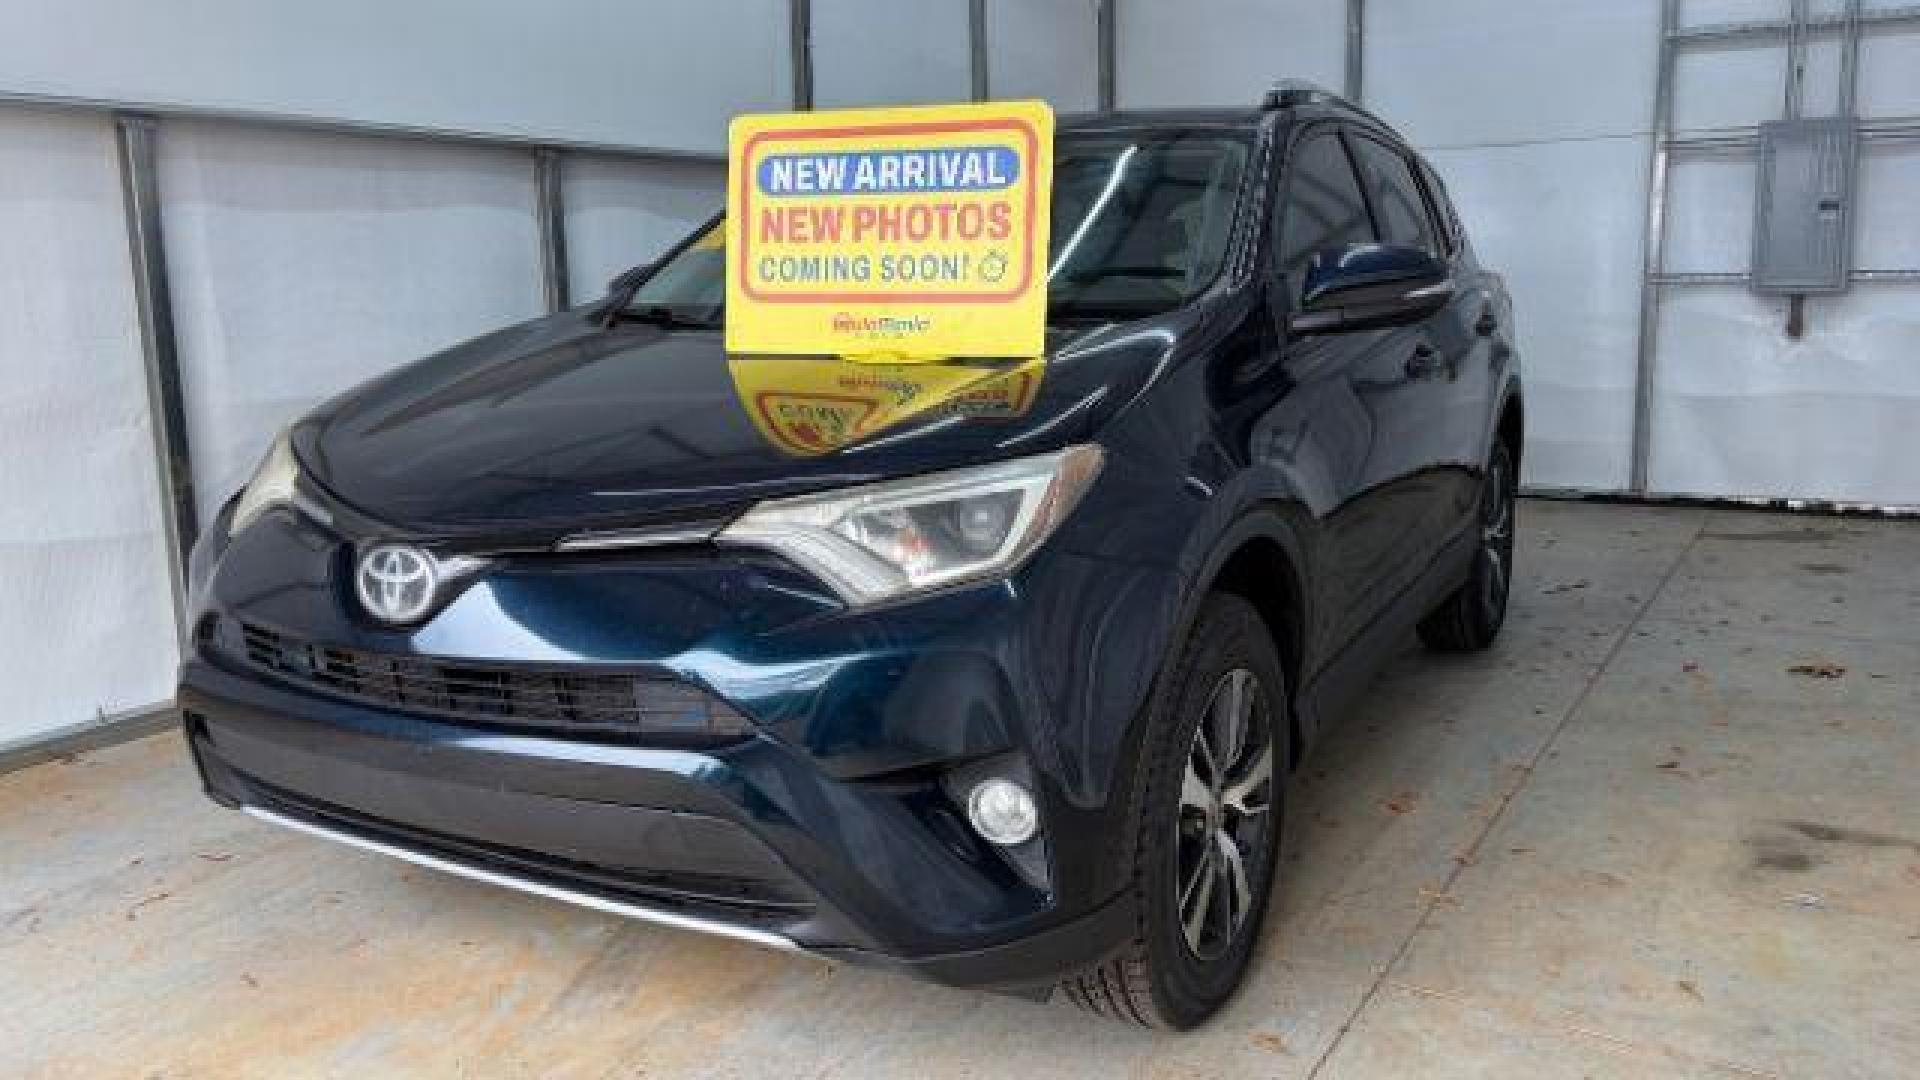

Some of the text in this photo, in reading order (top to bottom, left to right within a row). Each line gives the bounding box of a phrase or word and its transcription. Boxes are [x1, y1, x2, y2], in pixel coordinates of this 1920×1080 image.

[771, 152, 1005, 191] NEW ARRIVAL
[763, 203, 1011, 243] NEW PHOTOS
[760, 254, 969, 283] COMING SOON!
